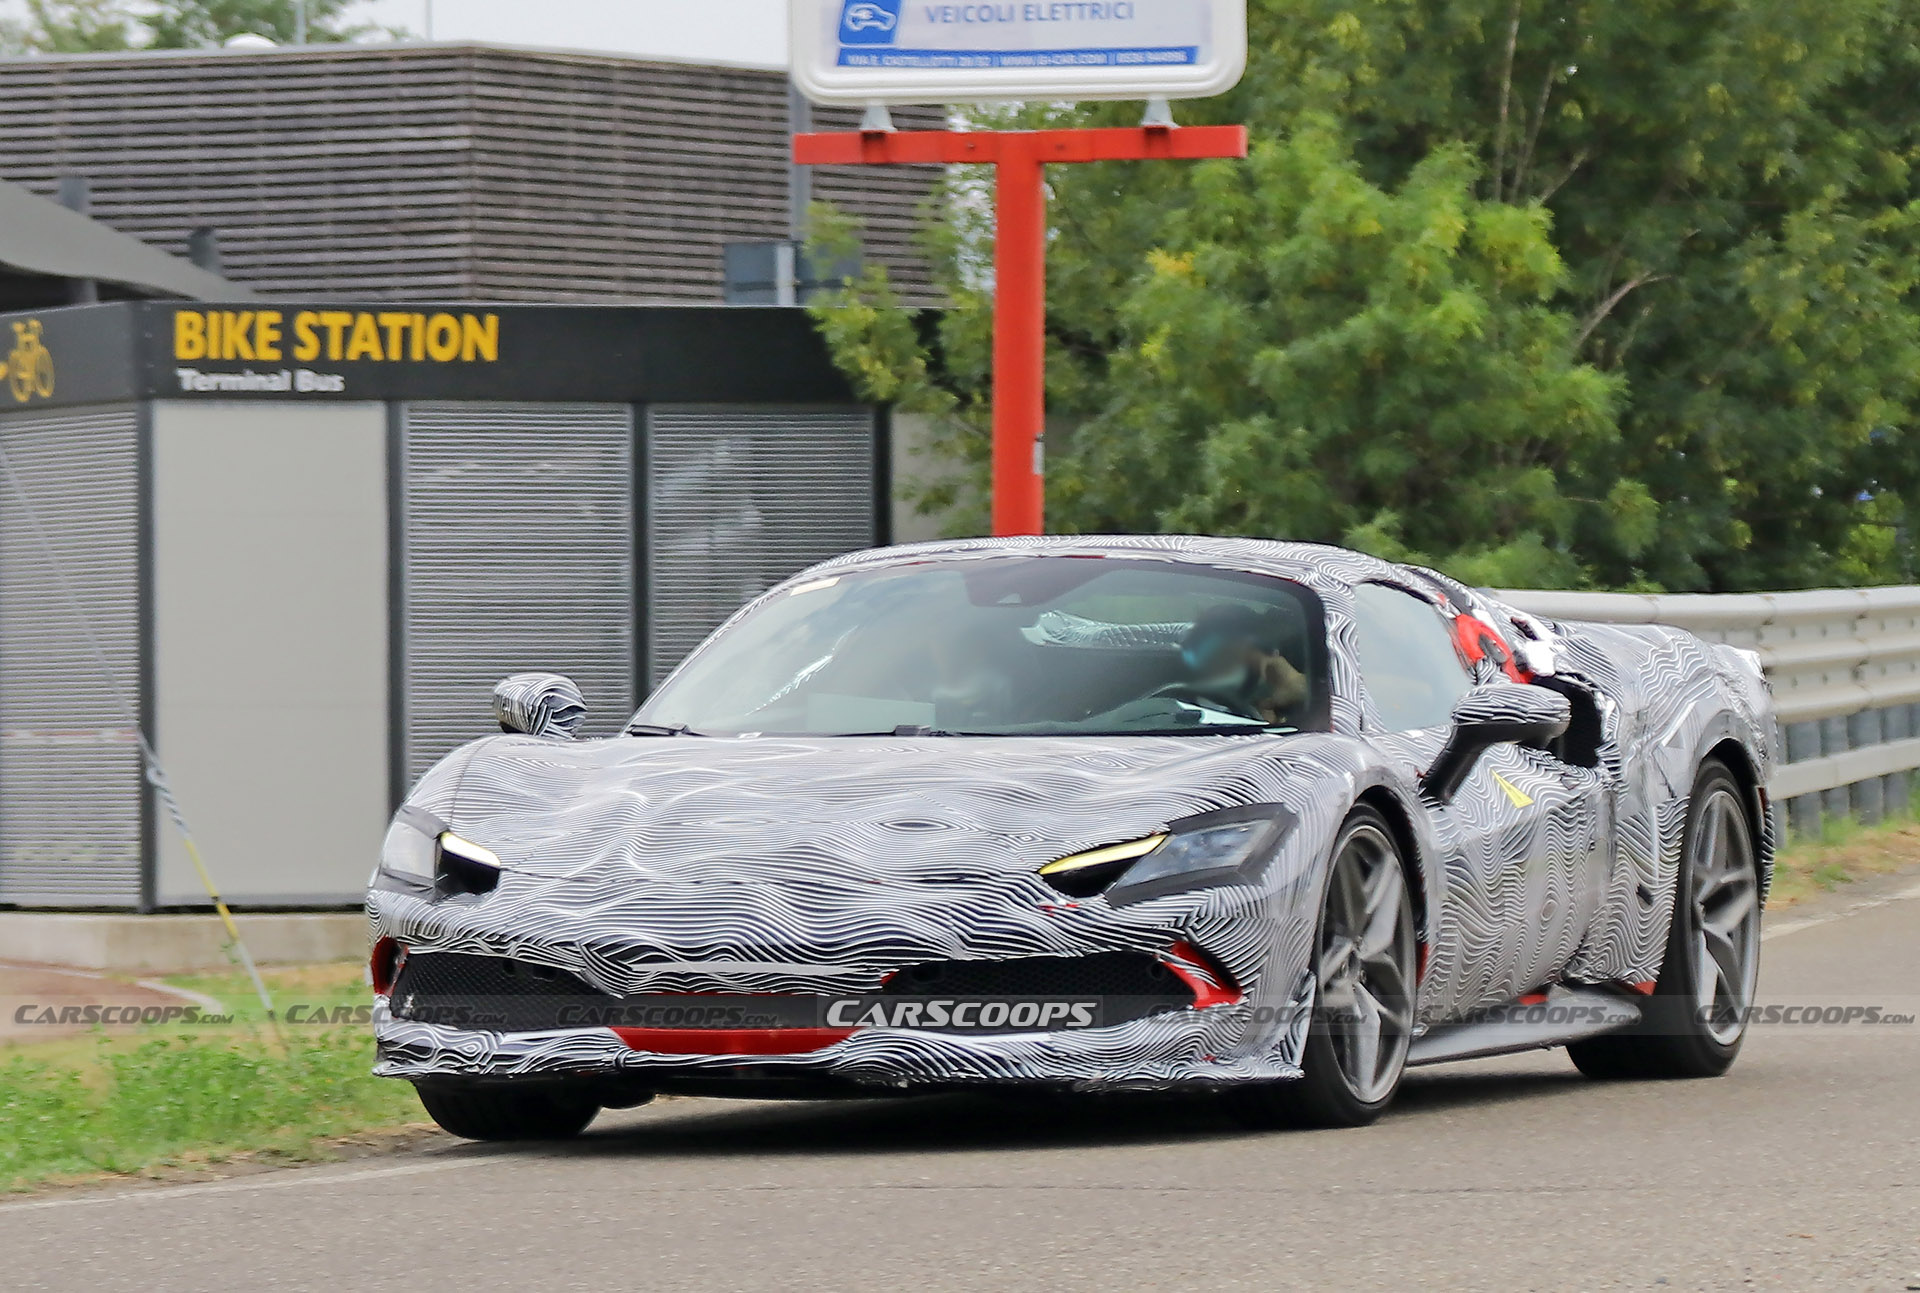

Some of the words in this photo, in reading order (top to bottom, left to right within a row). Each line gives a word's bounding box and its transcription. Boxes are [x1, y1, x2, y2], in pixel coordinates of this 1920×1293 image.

[925, 4, 1015, 24] VEICOLI
[1023, 1, 1135, 22] ELETTRICI
[173, 310, 282, 362] BIKE
[293, 311, 499, 362] STATION
[176, 367, 292, 392] Terminal
[294, 368, 346, 392] Bus
